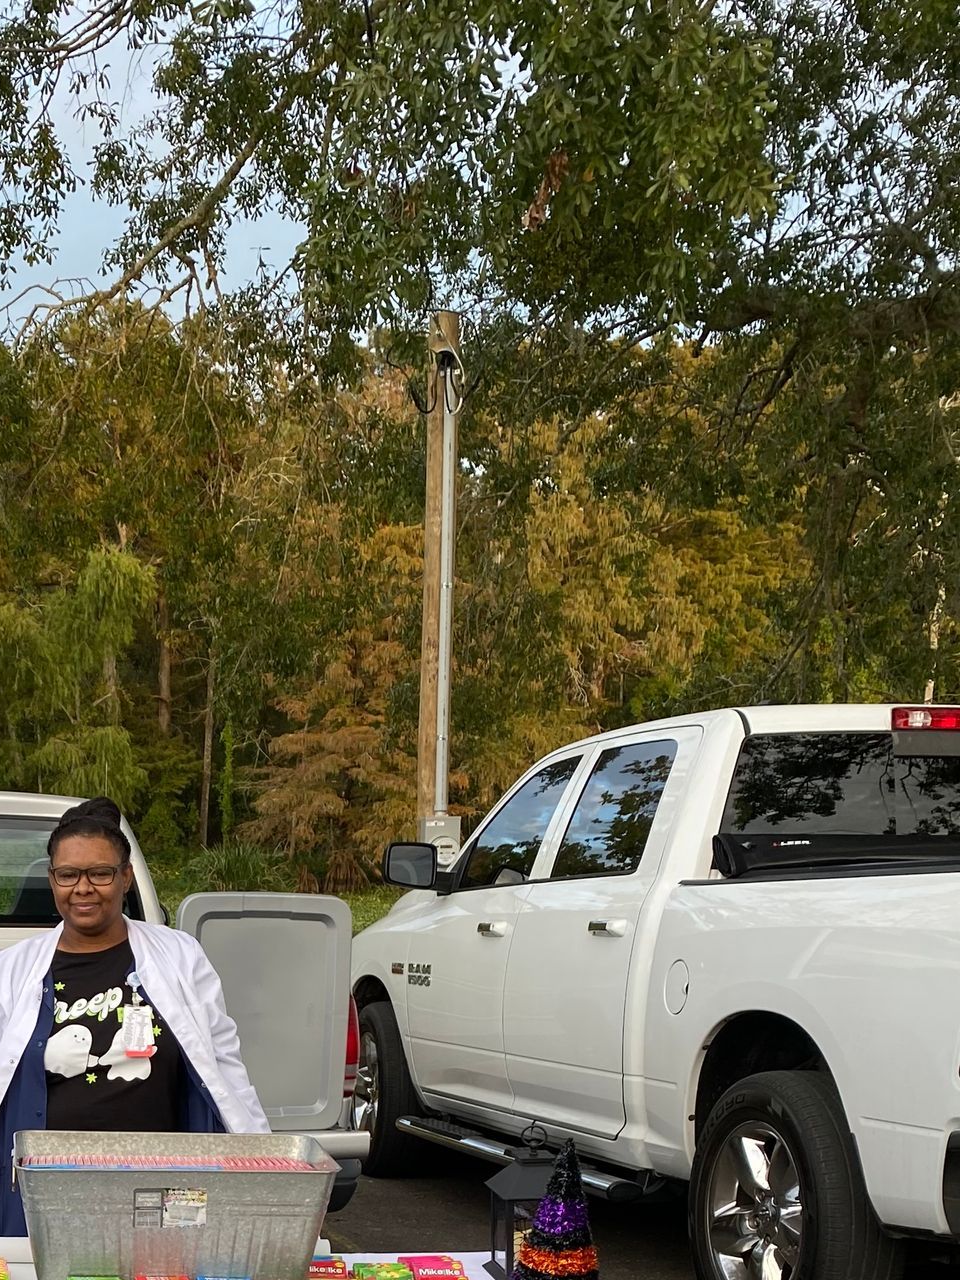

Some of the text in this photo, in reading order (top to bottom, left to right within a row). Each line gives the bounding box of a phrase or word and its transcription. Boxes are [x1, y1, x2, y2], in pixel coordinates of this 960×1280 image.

[408, 963, 431, 975] RAM
[53, 986, 123, 1024] reep
[419, 1268, 444, 1276] Mike
